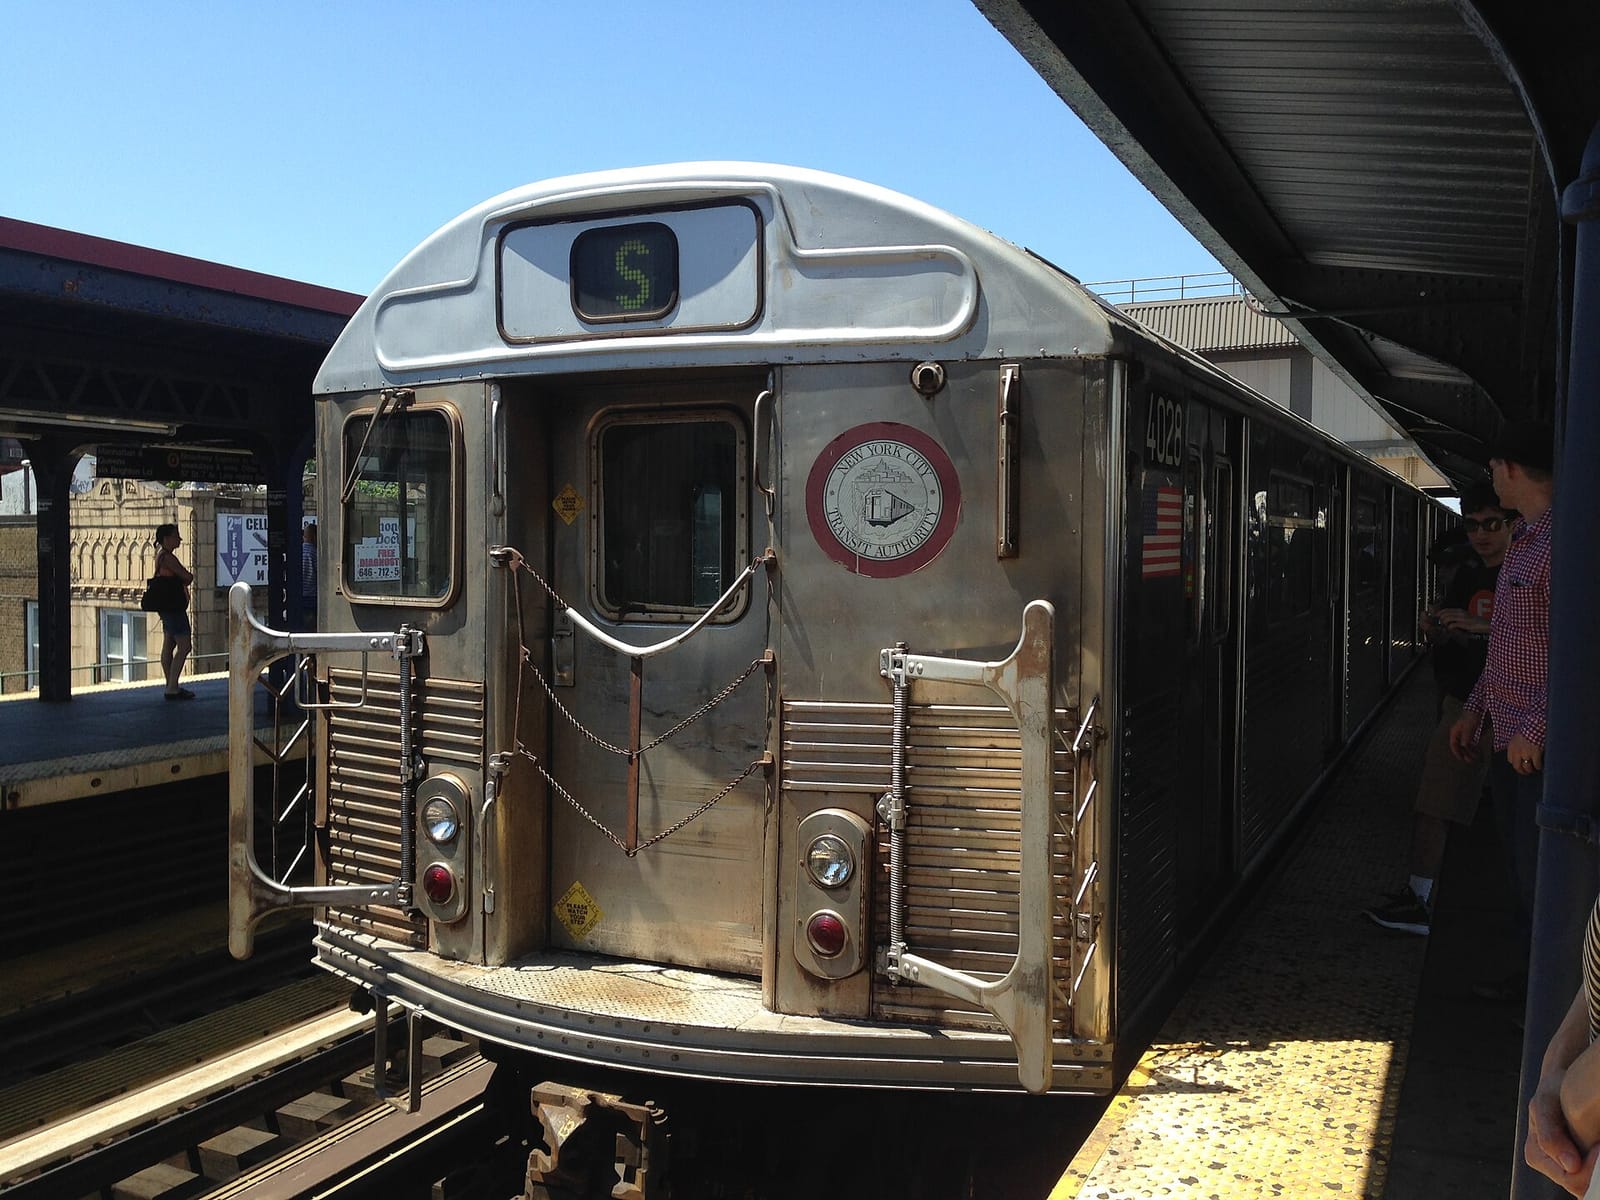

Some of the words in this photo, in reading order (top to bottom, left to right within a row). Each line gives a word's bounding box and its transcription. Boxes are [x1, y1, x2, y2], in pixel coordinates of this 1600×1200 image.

[616, 240, 649, 309] S
[1147, 392, 1182, 466] 4028
[837, 449, 864, 475] NEW
[867, 443, 902, 458] YORK
[906, 452, 934, 476] CITY
[378, 549, 395, 557] FREE
[829, 508, 872, 554] TRANSIT
[875, 509, 937, 557] AUTHORITY
[359, 558, 400, 567] DIAGNOST
